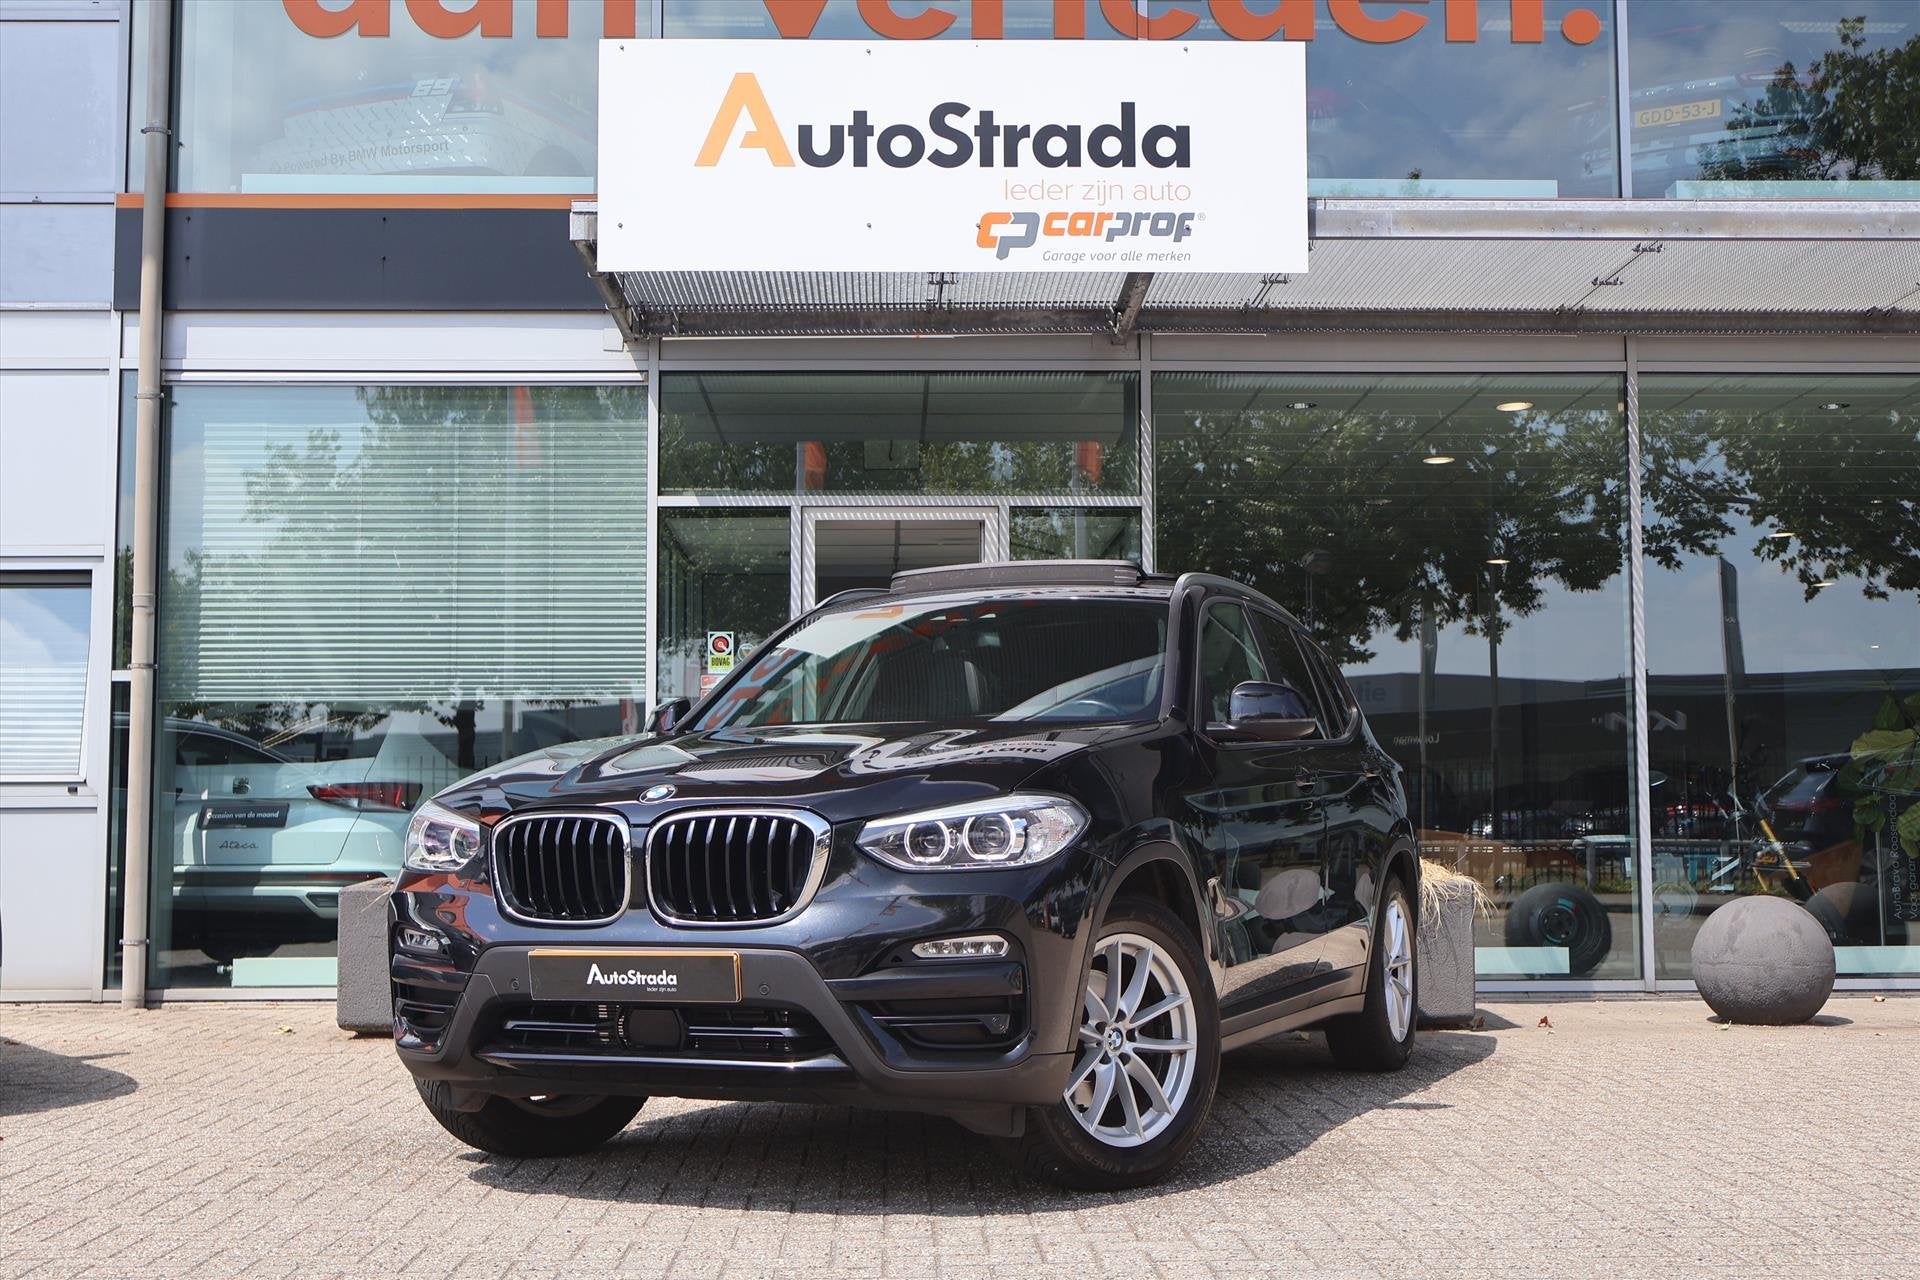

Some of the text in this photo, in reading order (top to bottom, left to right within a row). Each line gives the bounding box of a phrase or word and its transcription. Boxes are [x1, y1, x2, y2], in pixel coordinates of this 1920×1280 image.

[694, 72, 1191, 168] AutoStrada
[1640, 102, 1715, 125] GDD-53-J
[350, 147, 378, 162] BMW
[381, 141, 449, 158] Motorsport
[1005, 179, 1191, 206] Ieder zijn auto
[1042, 251, 1191, 264] Garage voor alle merken
[711, 657, 731, 667] BOVAG
[586, 963, 678, 985] AutoStrada
